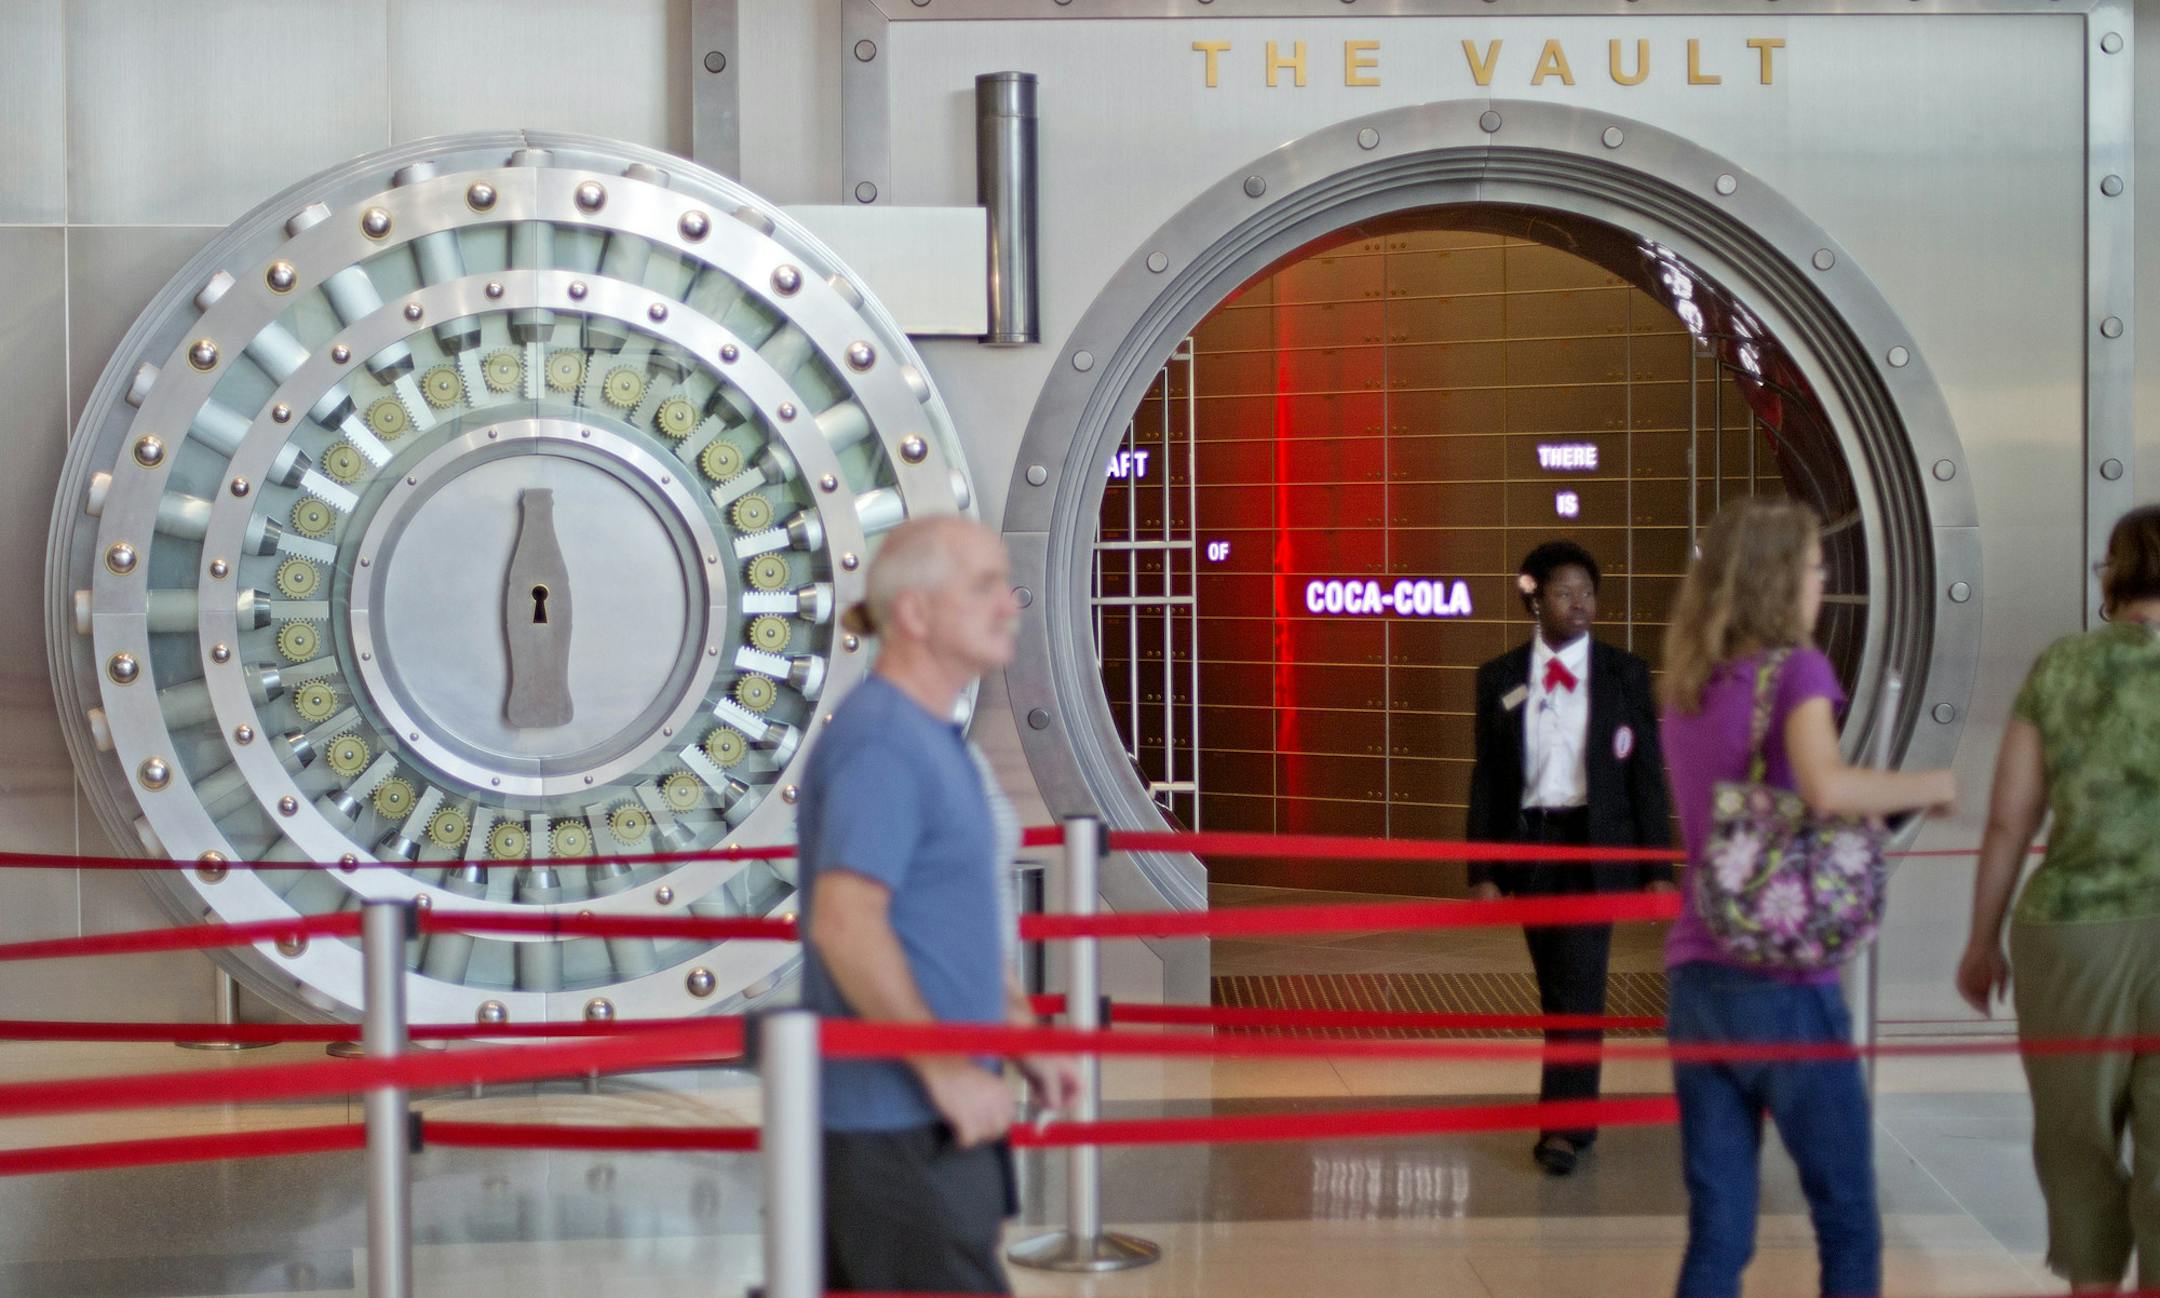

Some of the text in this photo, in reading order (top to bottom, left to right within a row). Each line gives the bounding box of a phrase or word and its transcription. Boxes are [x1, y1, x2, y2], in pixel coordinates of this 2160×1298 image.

[1192, 37, 1788, 88] THE VAULT
[1537, 444, 1599, 470] THERE
[1555, 491, 1580, 517] IS
[1207, 541, 1231, 562] OF
[1305, 579, 1473, 617] COCA-COLA
